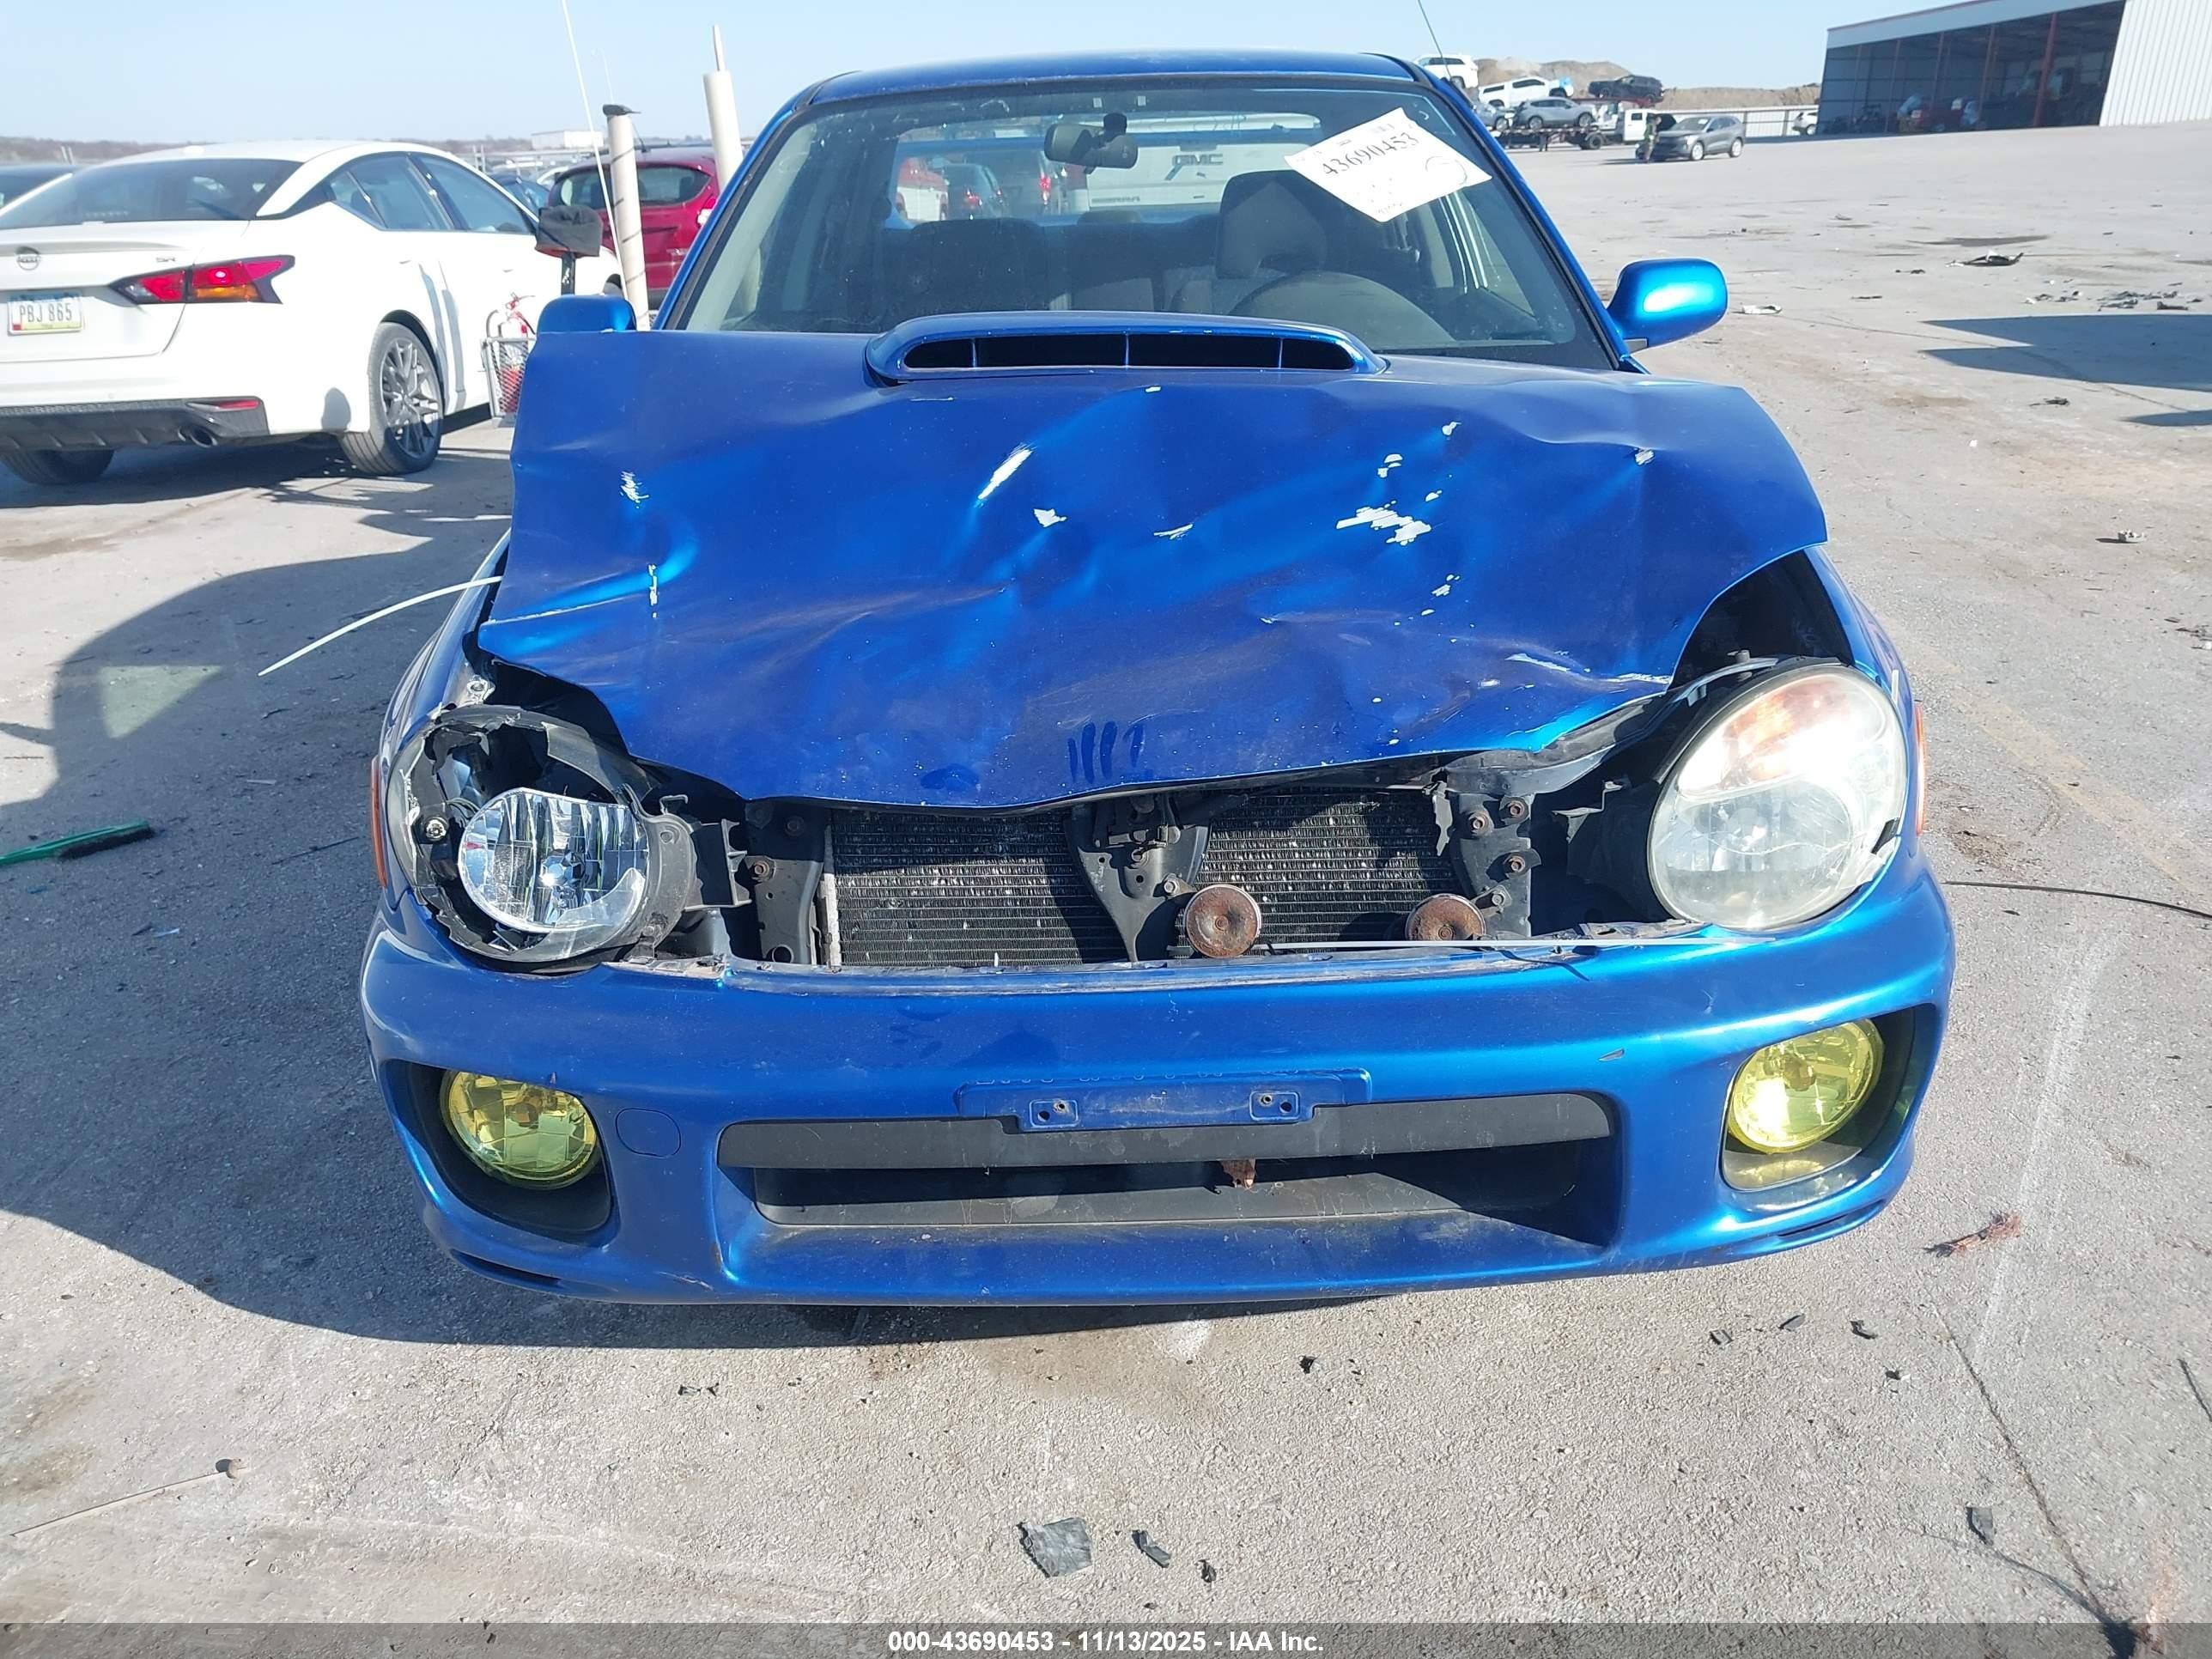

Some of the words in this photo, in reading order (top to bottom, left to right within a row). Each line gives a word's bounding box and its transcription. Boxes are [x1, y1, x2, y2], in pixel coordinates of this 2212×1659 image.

[1172, 154, 1223, 166] GMC
[1322, 131, 1419, 175] 43690453
[20, 303, 43, 324] PBJ
[48, 302, 72, 322] 865
